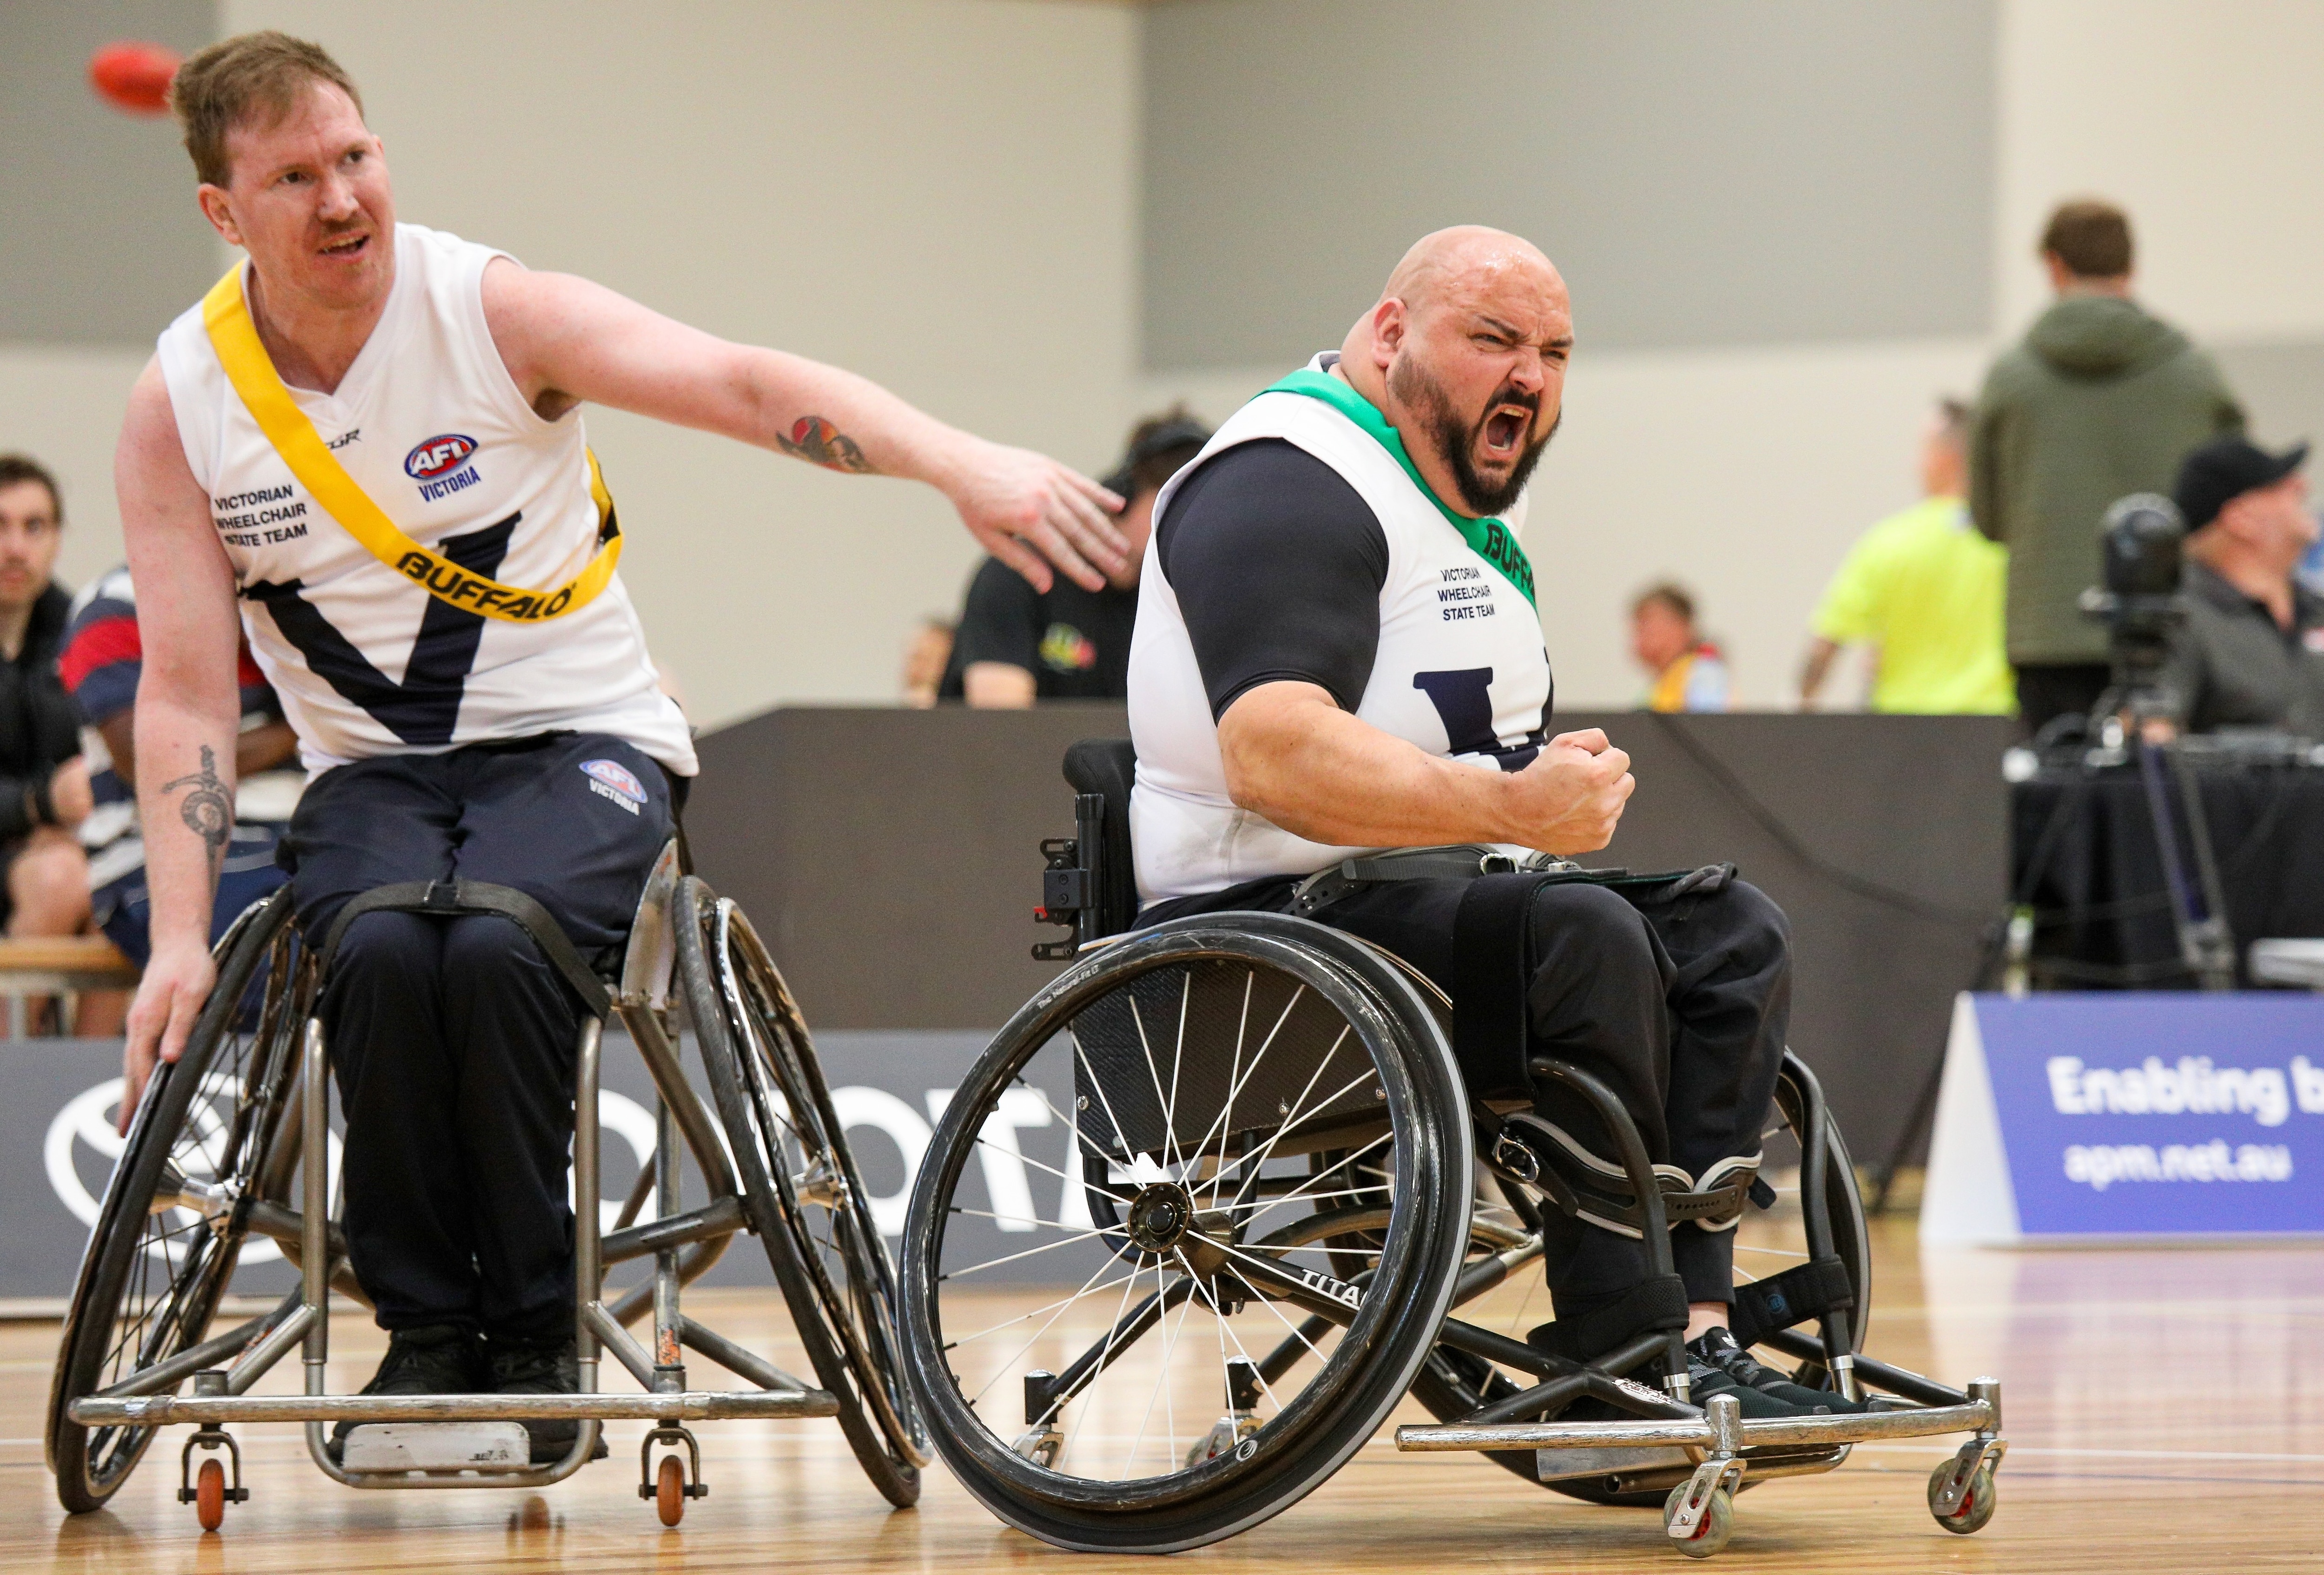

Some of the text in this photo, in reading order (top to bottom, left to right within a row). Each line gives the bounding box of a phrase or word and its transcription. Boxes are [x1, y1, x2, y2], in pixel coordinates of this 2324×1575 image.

[215, 484, 294, 511] VICTORIAN
[419, 466, 481, 501] VICTORIA
[264, 523, 308, 544] TEAM
[396, 551, 572, 619] BUFFALO
[1440, 567, 1480, 581] VICTORIAN
[1438, 585, 1491, 602] WHEELCHAIR
[1443, 603, 1494, 620] STATE TEAM
[589, 778, 640, 816] VICTORIA
[2047, 1055, 2291, 1127] Enabling
[1302, 1269, 1368, 1307] TITA
